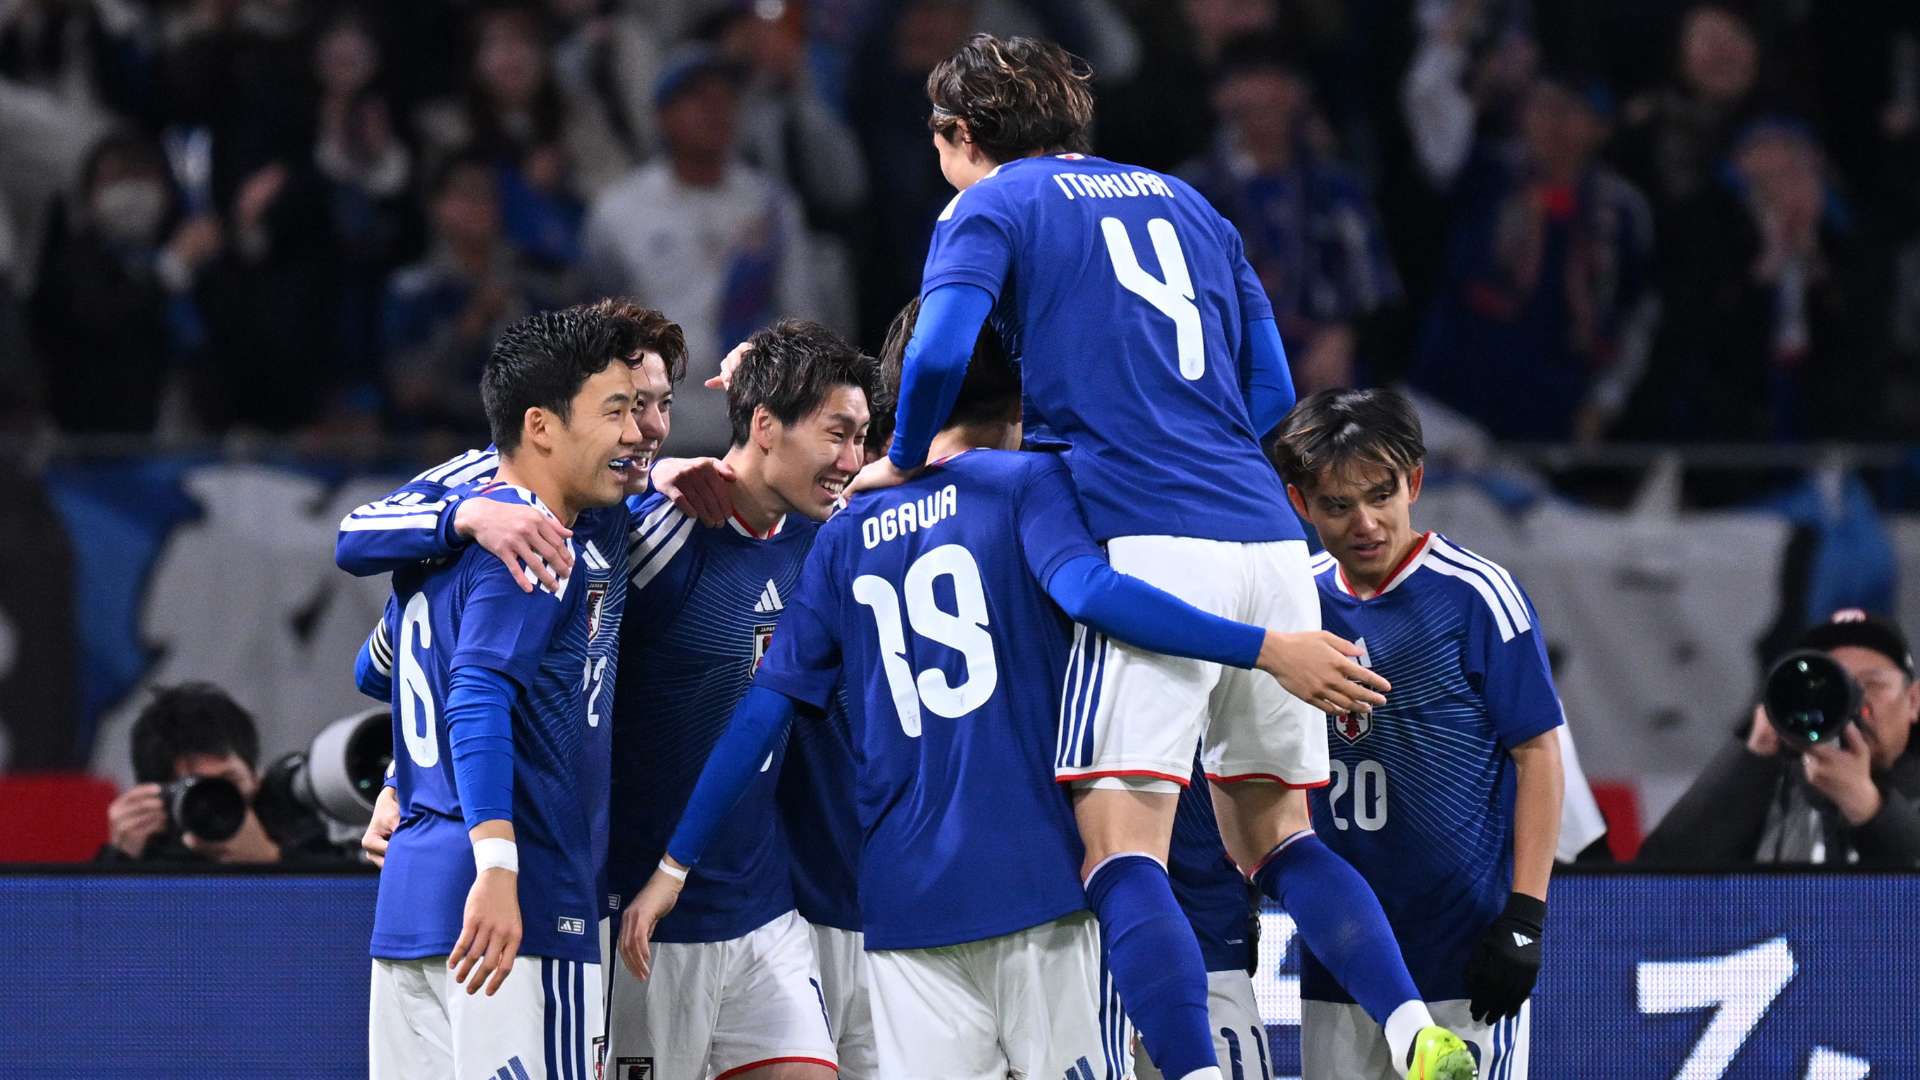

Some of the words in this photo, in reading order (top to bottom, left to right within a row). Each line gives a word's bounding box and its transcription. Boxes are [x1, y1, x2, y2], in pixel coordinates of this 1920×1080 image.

[1052, 171, 1175, 200] ITAKURA
[1100, 216, 1205, 381] 4
[862, 484, 957, 550] OGAWA
[399, 591, 439, 768] 6
[852, 543, 998, 738] 19
[1329, 759, 1388, 831] 20
